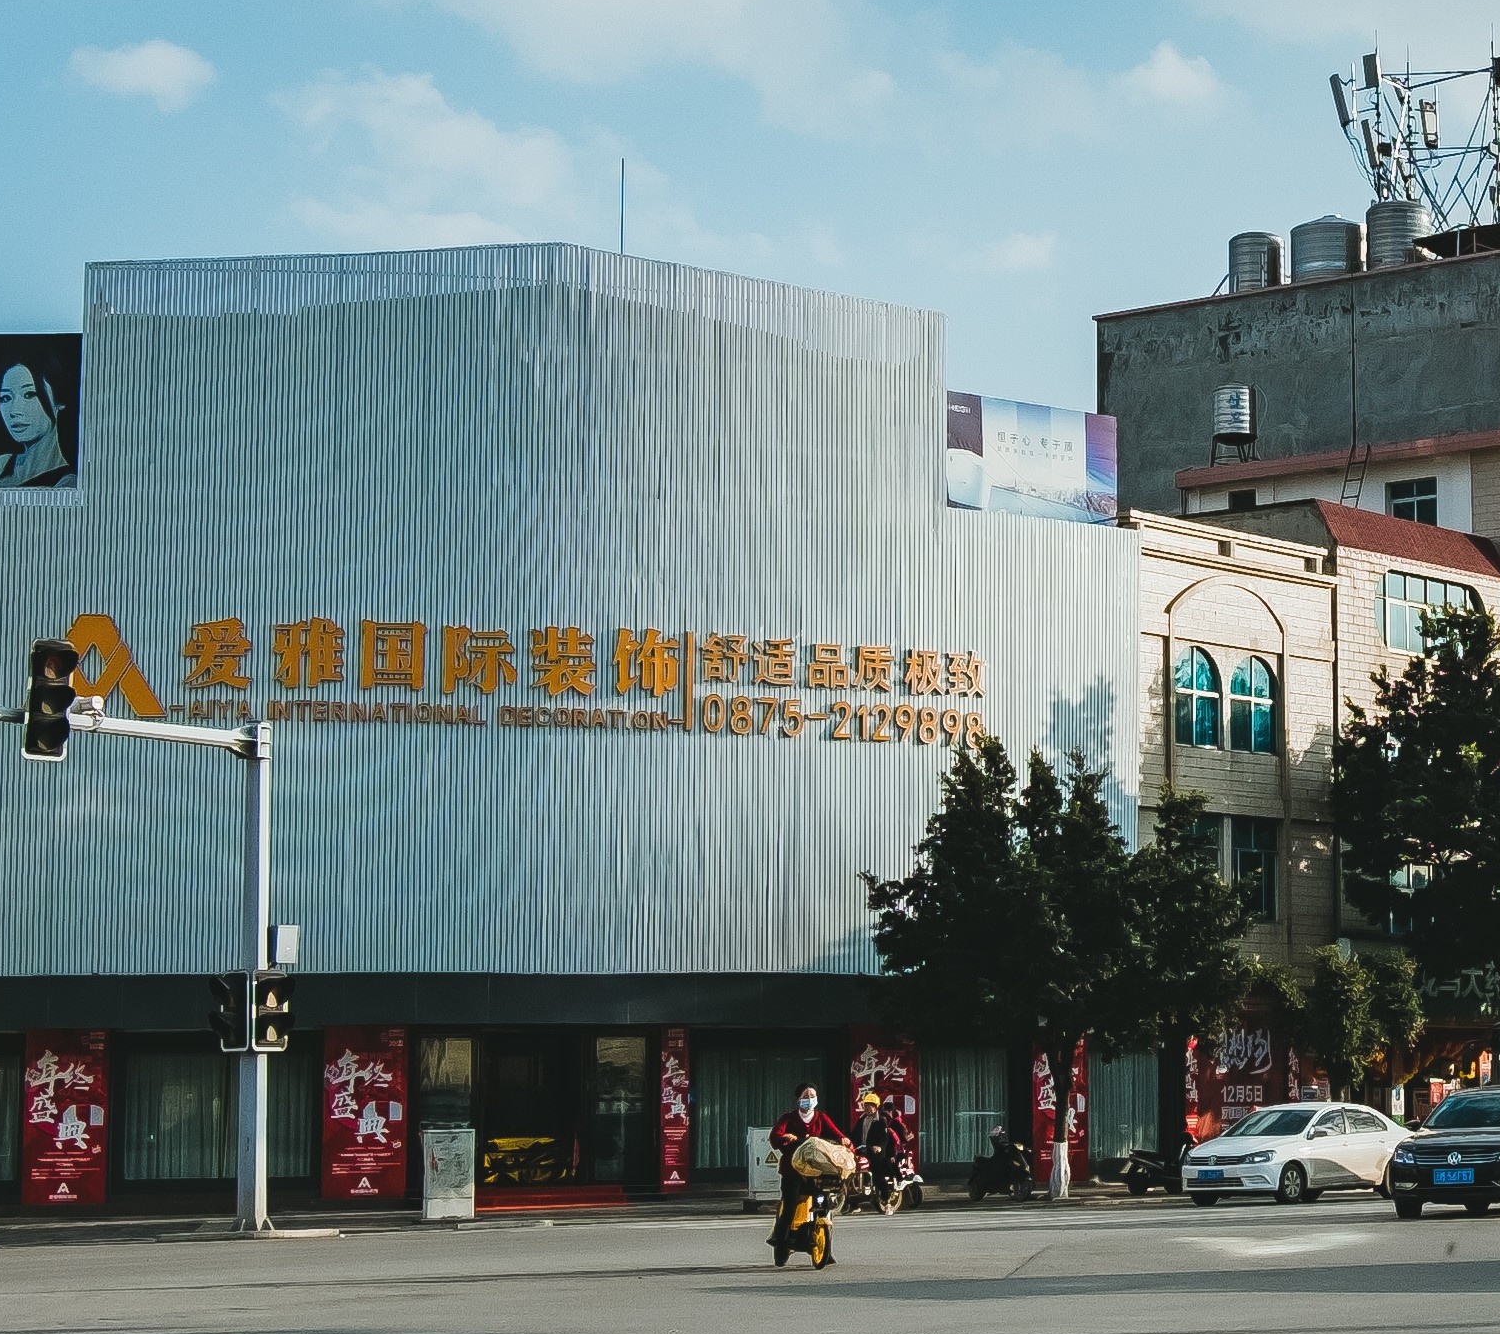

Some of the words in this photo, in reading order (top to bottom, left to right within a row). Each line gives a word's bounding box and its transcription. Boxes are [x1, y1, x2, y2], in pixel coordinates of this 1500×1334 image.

[184, 617, 680, 698] 爱雅国际装饰
[702, 633, 987, 698] 舒适品质极致
[268, 700, 487, 726] INTERNATIONAL
[703, 693, 985, 750] 0875-2129898
[1220, 1085, 1263, 1103] 12月5日
